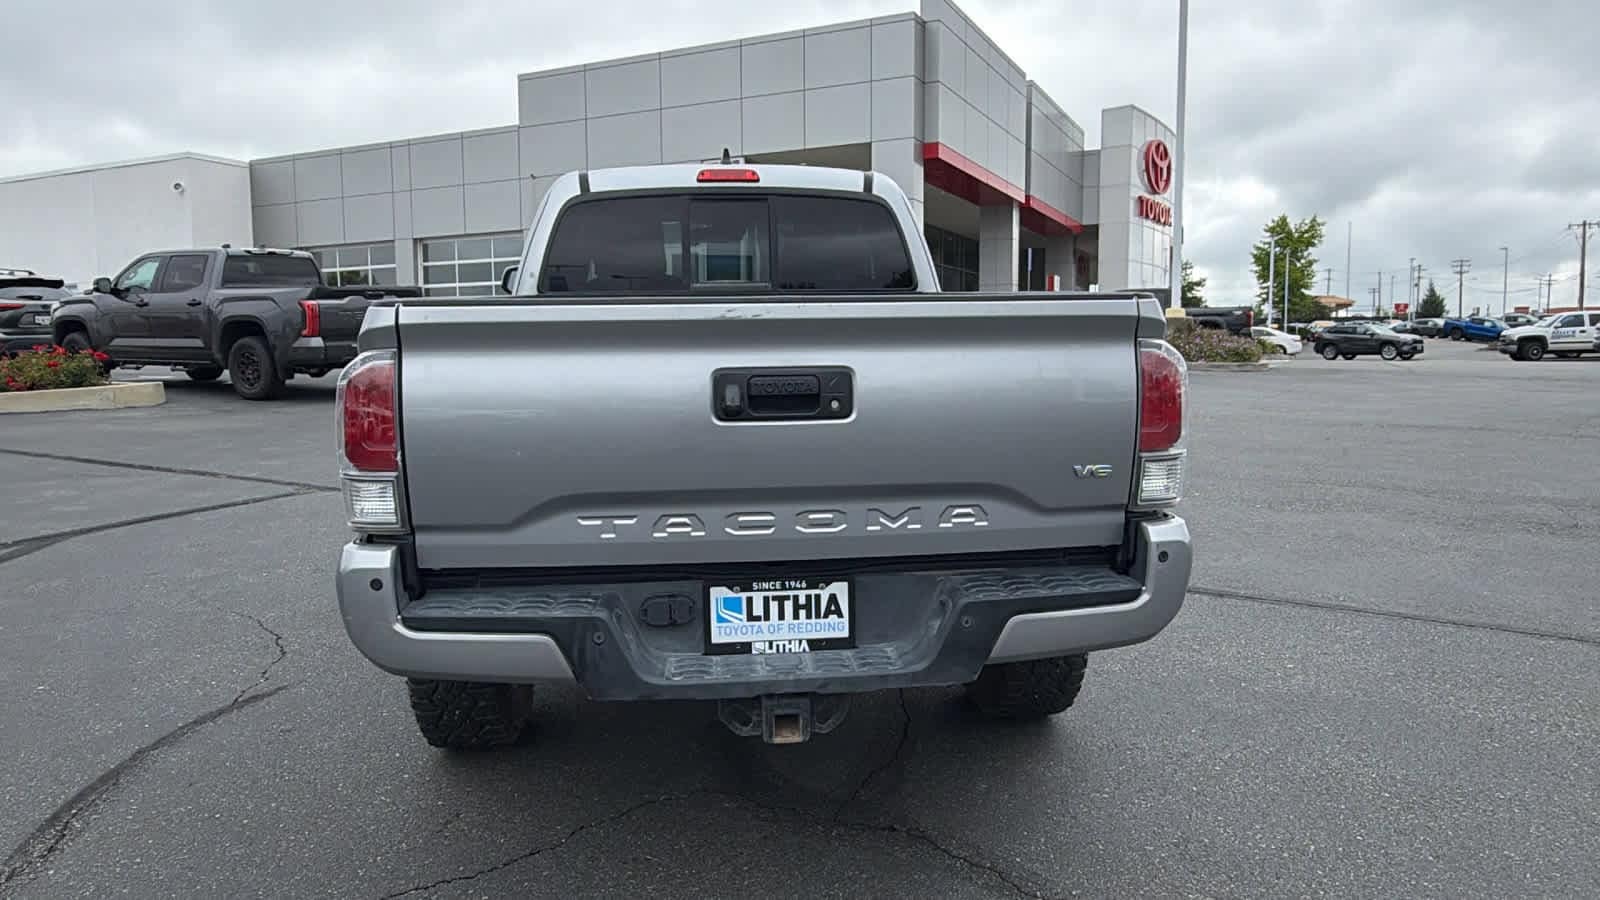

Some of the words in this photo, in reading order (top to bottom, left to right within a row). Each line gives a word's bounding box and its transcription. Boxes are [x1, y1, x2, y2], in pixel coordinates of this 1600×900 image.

[1137, 195, 1172, 227] TOYOTA
[754, 382, 818, 393] TOYOTA
[1072, 464, 1113, 480] V6
[577, 504, 989, 539] TACOMA
[752, 581, 782, 590] SINCE
[785, 580, 807, 589] 1946
[746, 593, 844, 622] LITHIA
[716, 624, 764, 637] TOYOTA
[767, 623, 784, 634] OF
[788, 621, 846, 634] REDDING
[765, 639, 810, 654] LITHIA
